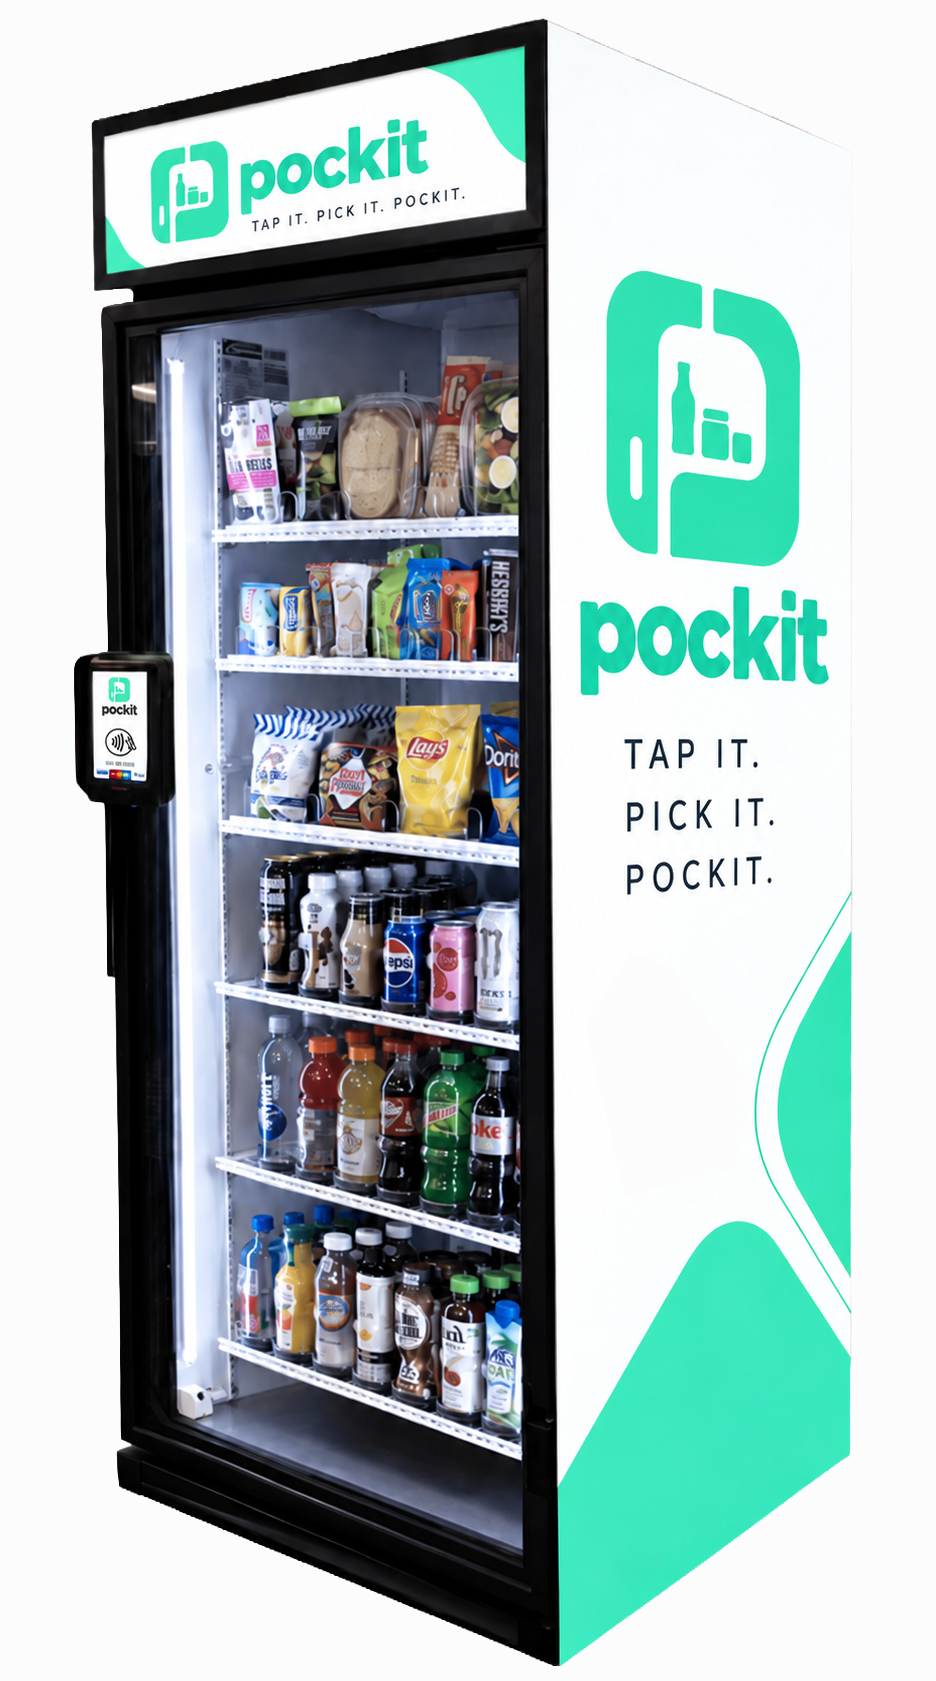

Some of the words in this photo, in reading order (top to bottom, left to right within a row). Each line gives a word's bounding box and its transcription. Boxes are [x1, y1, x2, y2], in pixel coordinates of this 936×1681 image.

[240, 118, 430, 216] pockit
[251, 216, 281, 232] TAP
[288, 212, 308, 227] IT.
[316, 204, 355, 222] PICK
[363, 200, 384, 215] IT.
[393, 187, 466, 210] POCKIT.
[580, 586, 829, 696] pockit
[101, 704, 138, 716] pockit
[624, 738, 695, 769] TAP
[717, 738, 759, 769] IT.
[626, 799, 713, 832] PICK
[734, 797, 775, 828] IT.
[626, 855, 773, 895] POCKIT.
[384, 955, 414, 971] epsi
